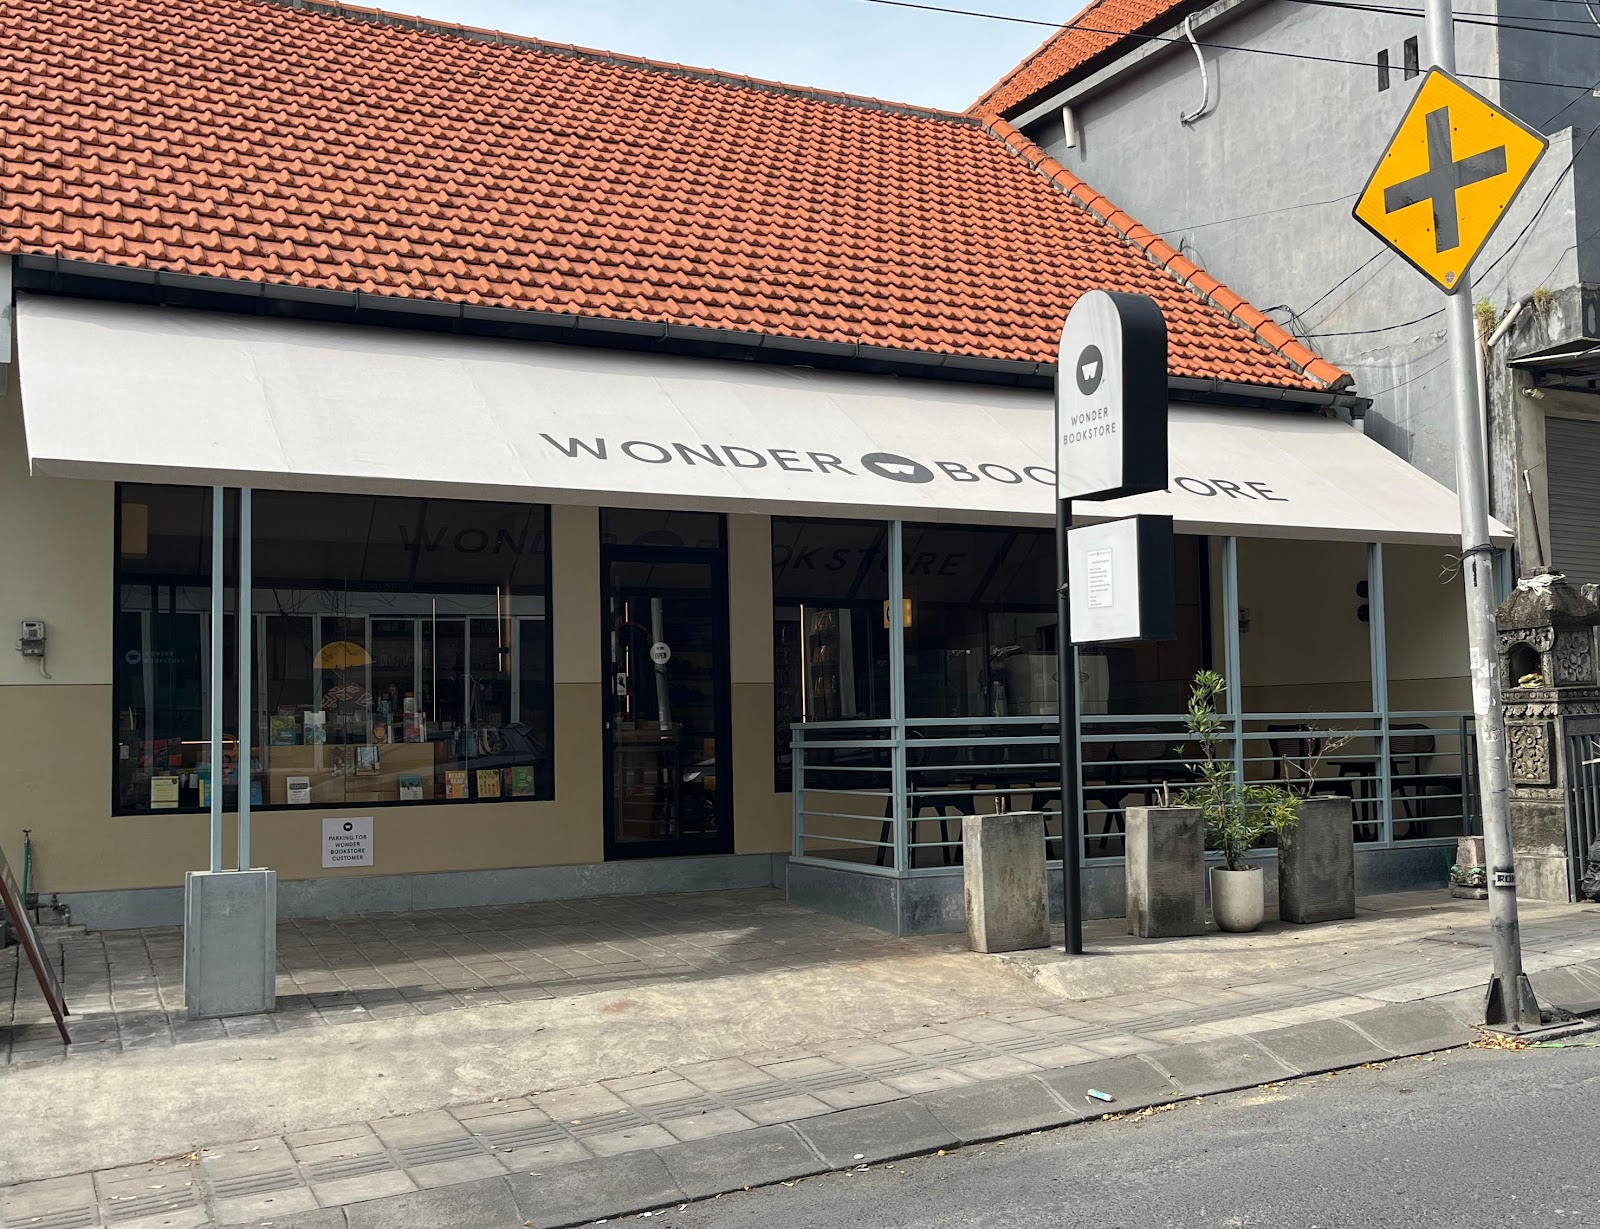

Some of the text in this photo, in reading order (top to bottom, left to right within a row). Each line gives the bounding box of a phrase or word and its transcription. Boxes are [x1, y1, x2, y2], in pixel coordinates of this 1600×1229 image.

[1071, 407, 1109, 426] WONDER
[1063, 422, 1117, 445] BOOKSTORE
[538, 432, 1290, 502] WONDER BOOORE
